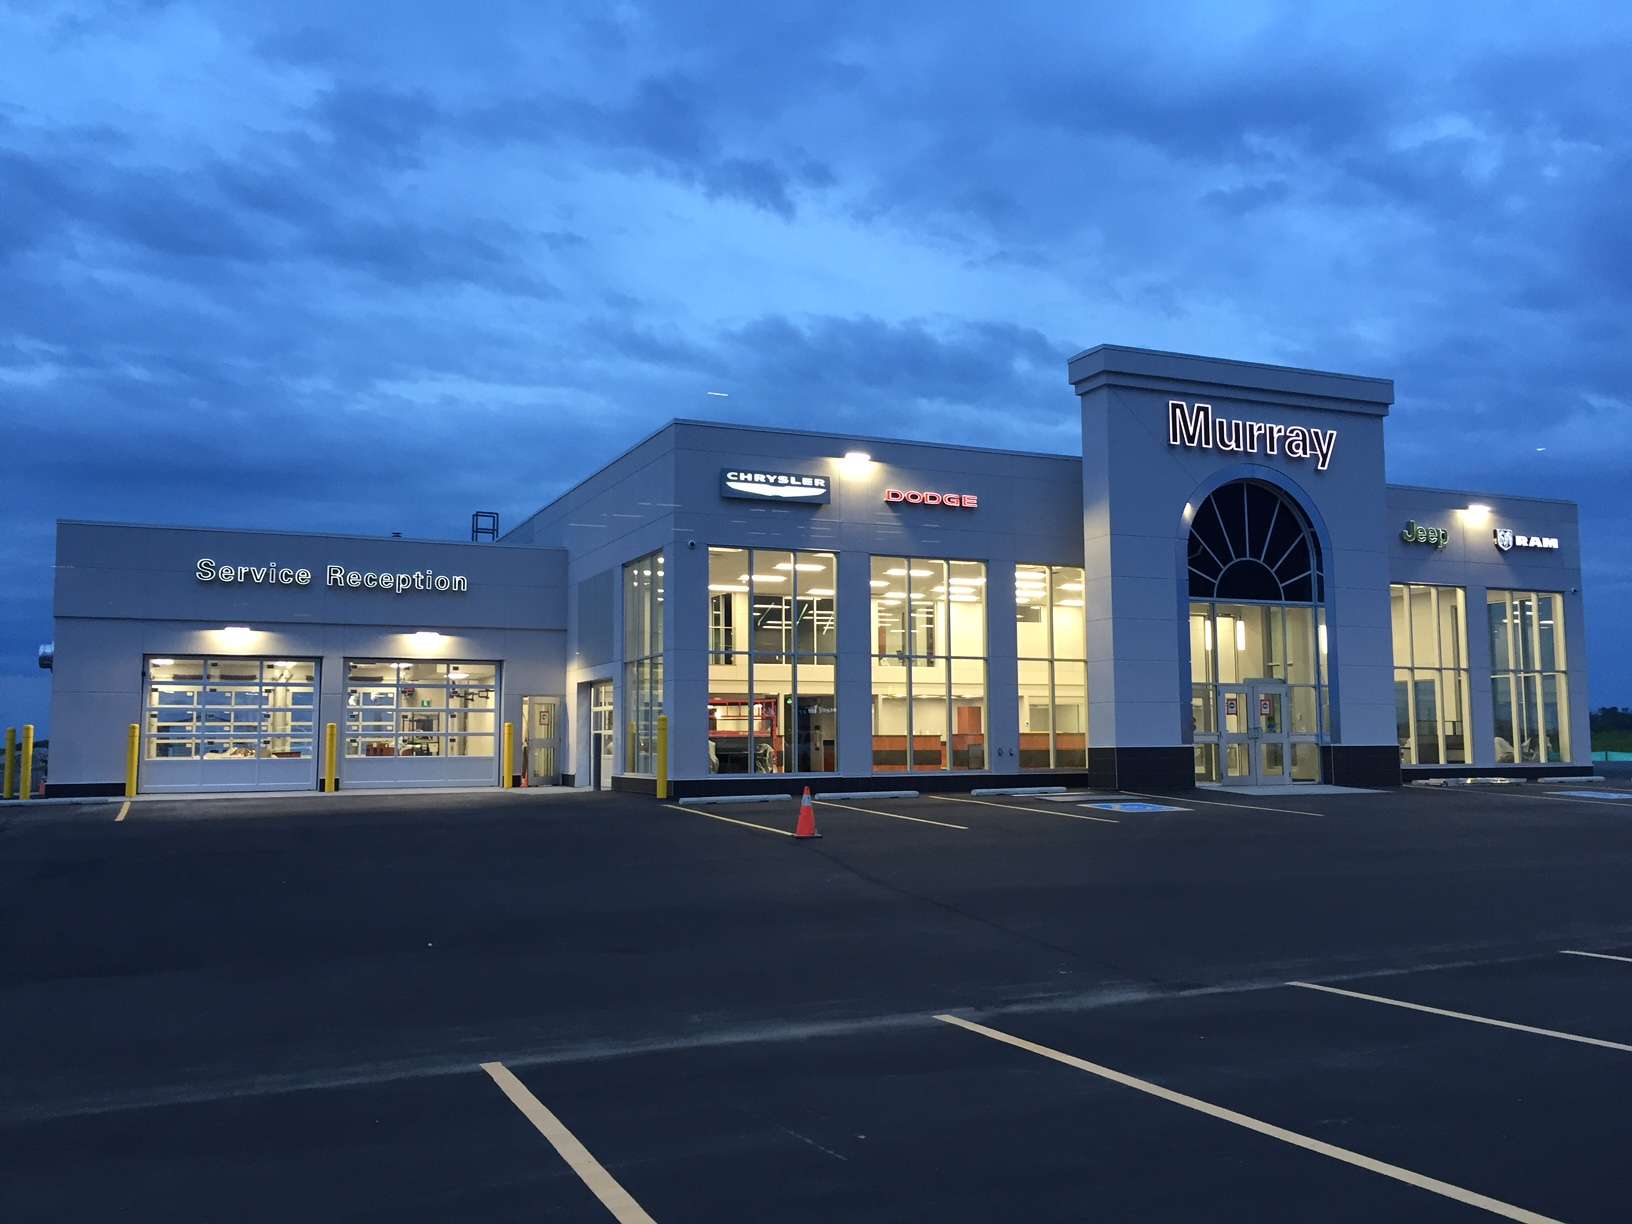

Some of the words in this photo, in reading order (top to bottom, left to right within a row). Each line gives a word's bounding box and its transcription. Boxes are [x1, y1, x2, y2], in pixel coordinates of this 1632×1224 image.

[1168, 400, 1337, 471] Murray
[726, 471, 826, 487] CHRYSLER
[884, 488, 978, 508] DODGE
[1402, 519, 1450, 549] Jeep
[1515, 535, 1559, 549] RAM
[196, 558, 311, 585] Service
[326, 565, 468, 593] Reception
